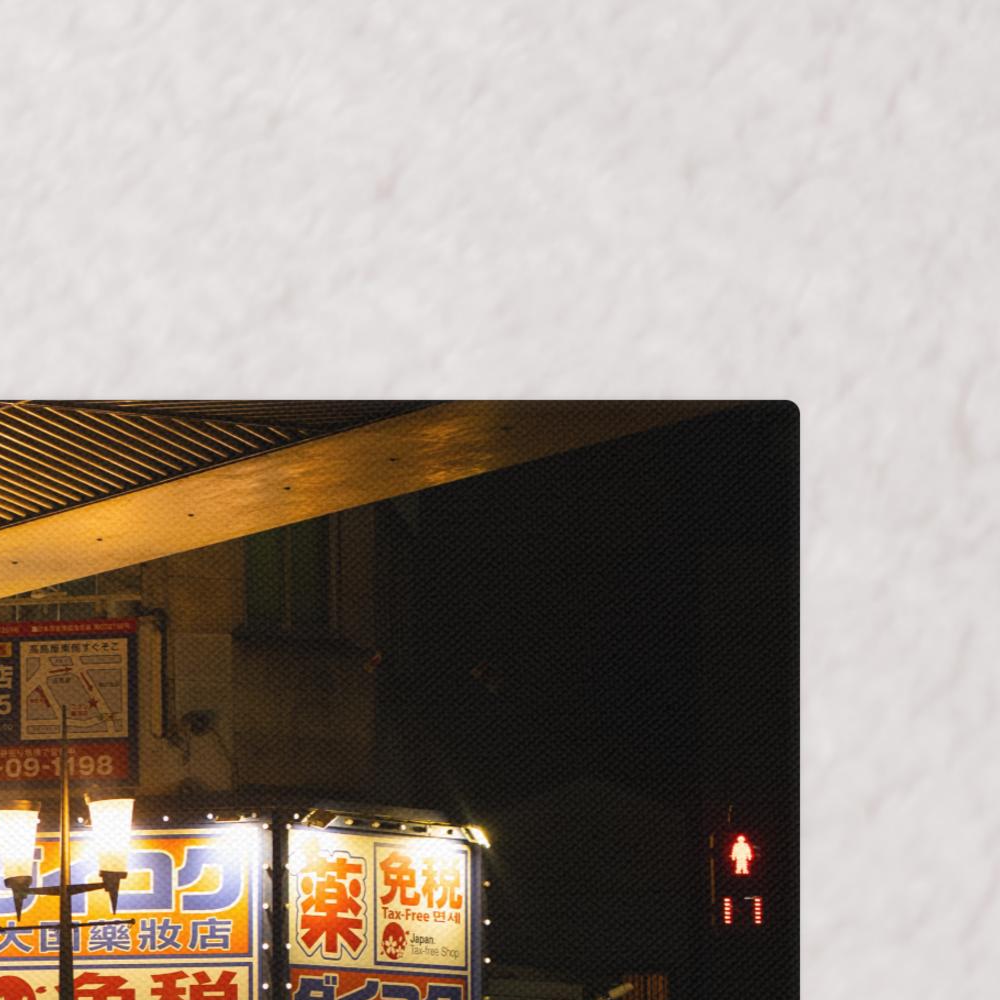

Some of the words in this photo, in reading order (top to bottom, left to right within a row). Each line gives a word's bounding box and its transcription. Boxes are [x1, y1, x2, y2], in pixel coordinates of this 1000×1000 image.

[379, 852, 464, 910] 免税
[300, 856, 363, 953] 薬
[381, 906, 430, 922] Tax-Free
[432, 910, 461, 924] 면세
